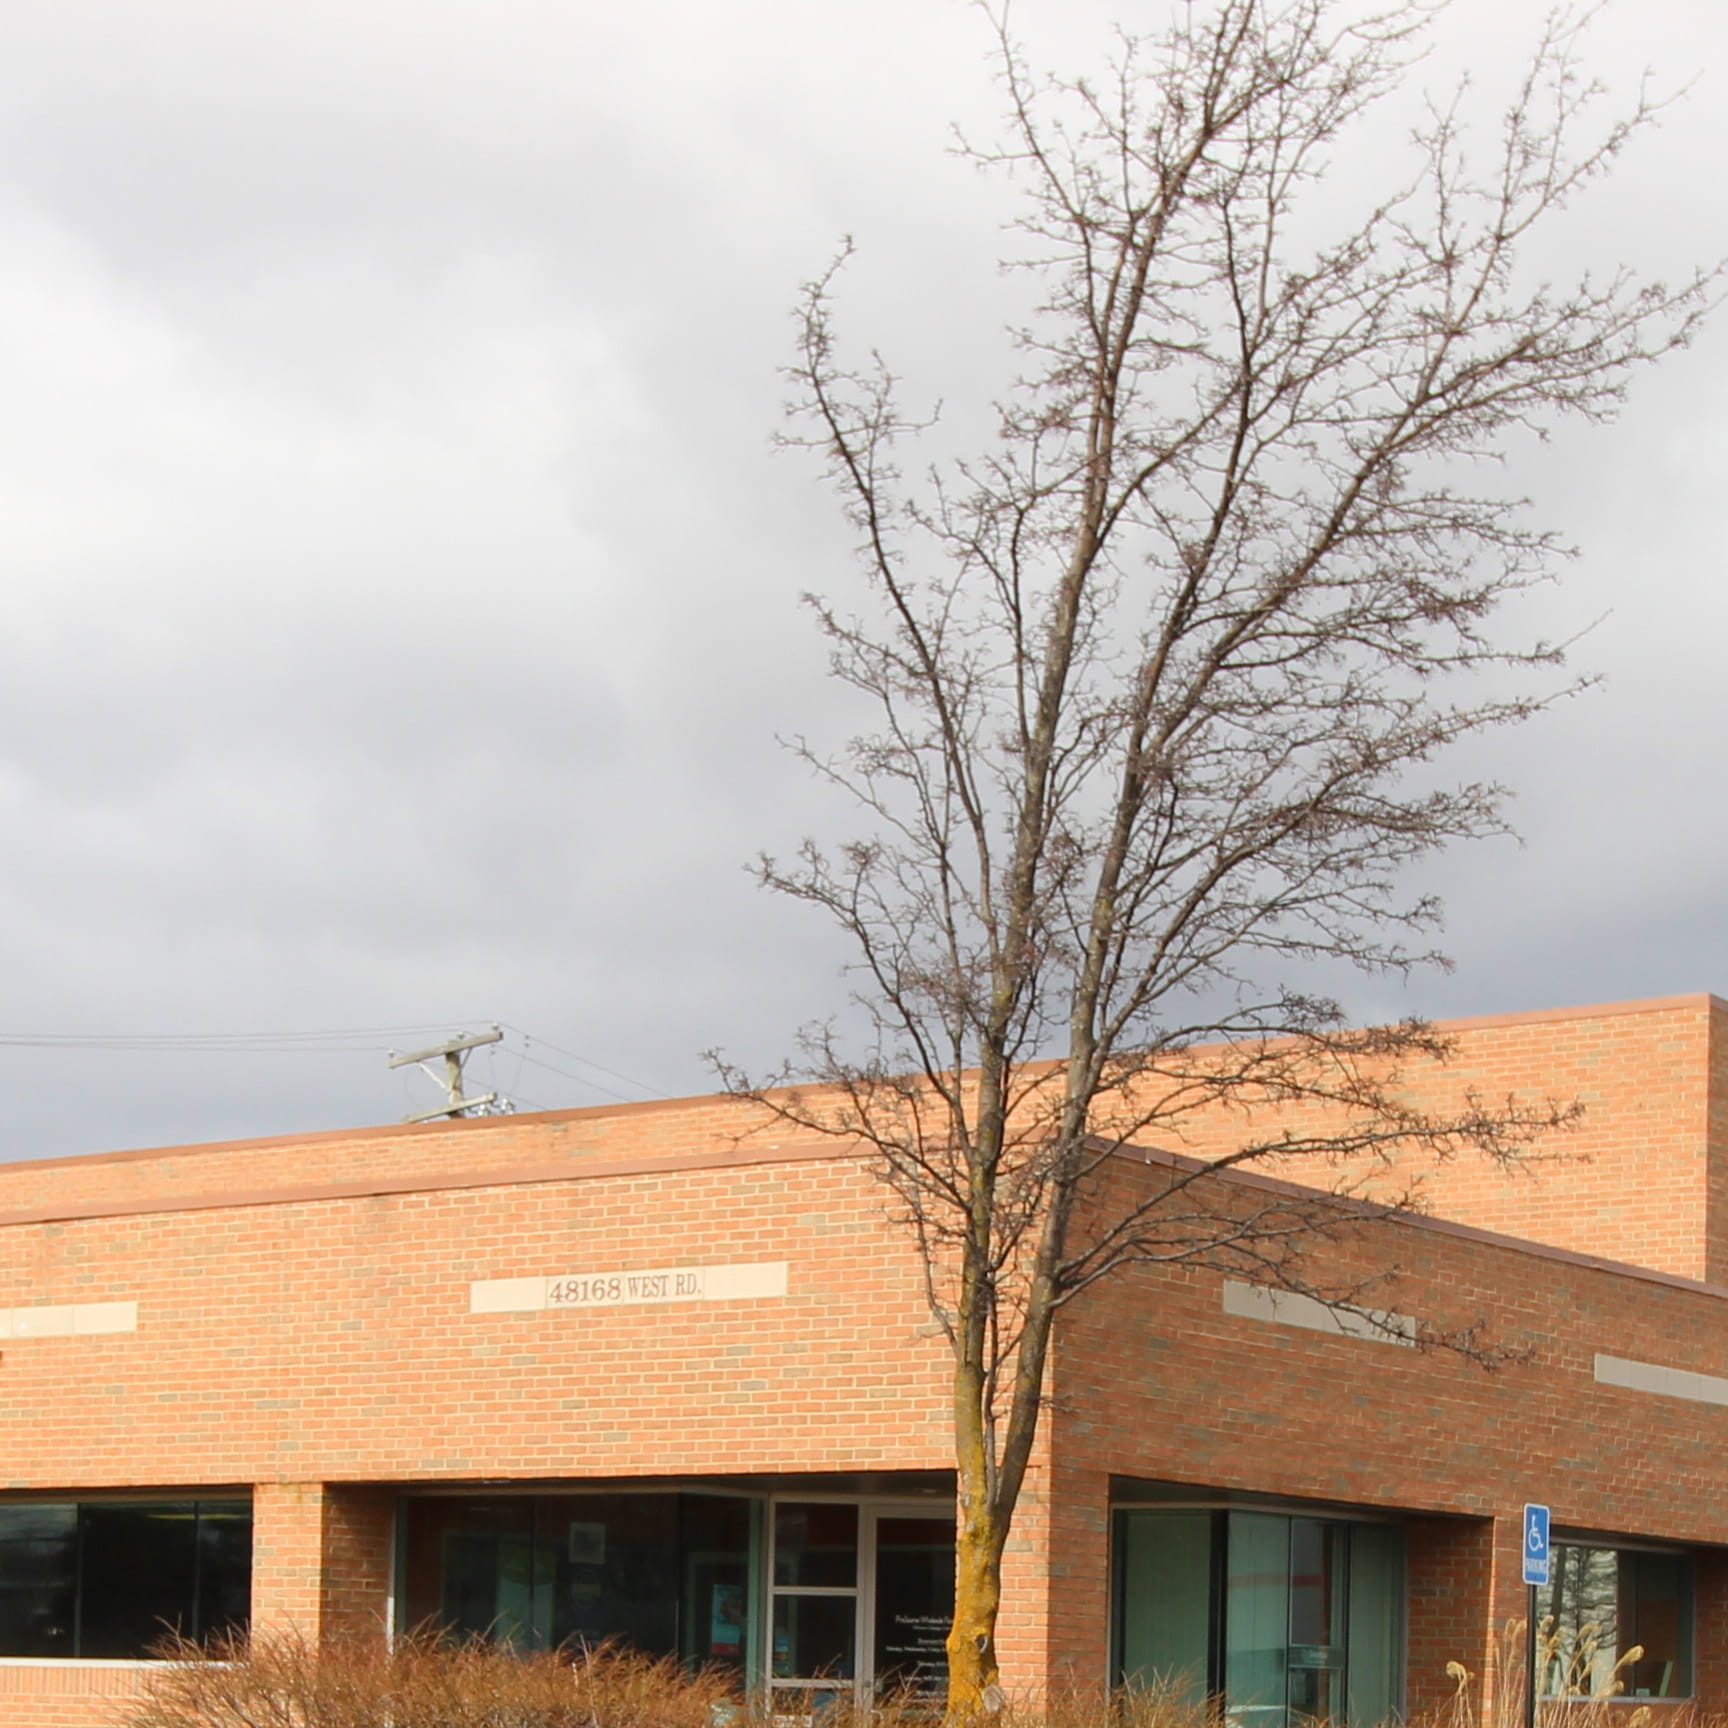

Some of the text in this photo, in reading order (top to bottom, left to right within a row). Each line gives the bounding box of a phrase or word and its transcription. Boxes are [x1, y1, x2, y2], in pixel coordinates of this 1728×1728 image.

[549, 1273, 702, 1304] 48168 WEST RD.
